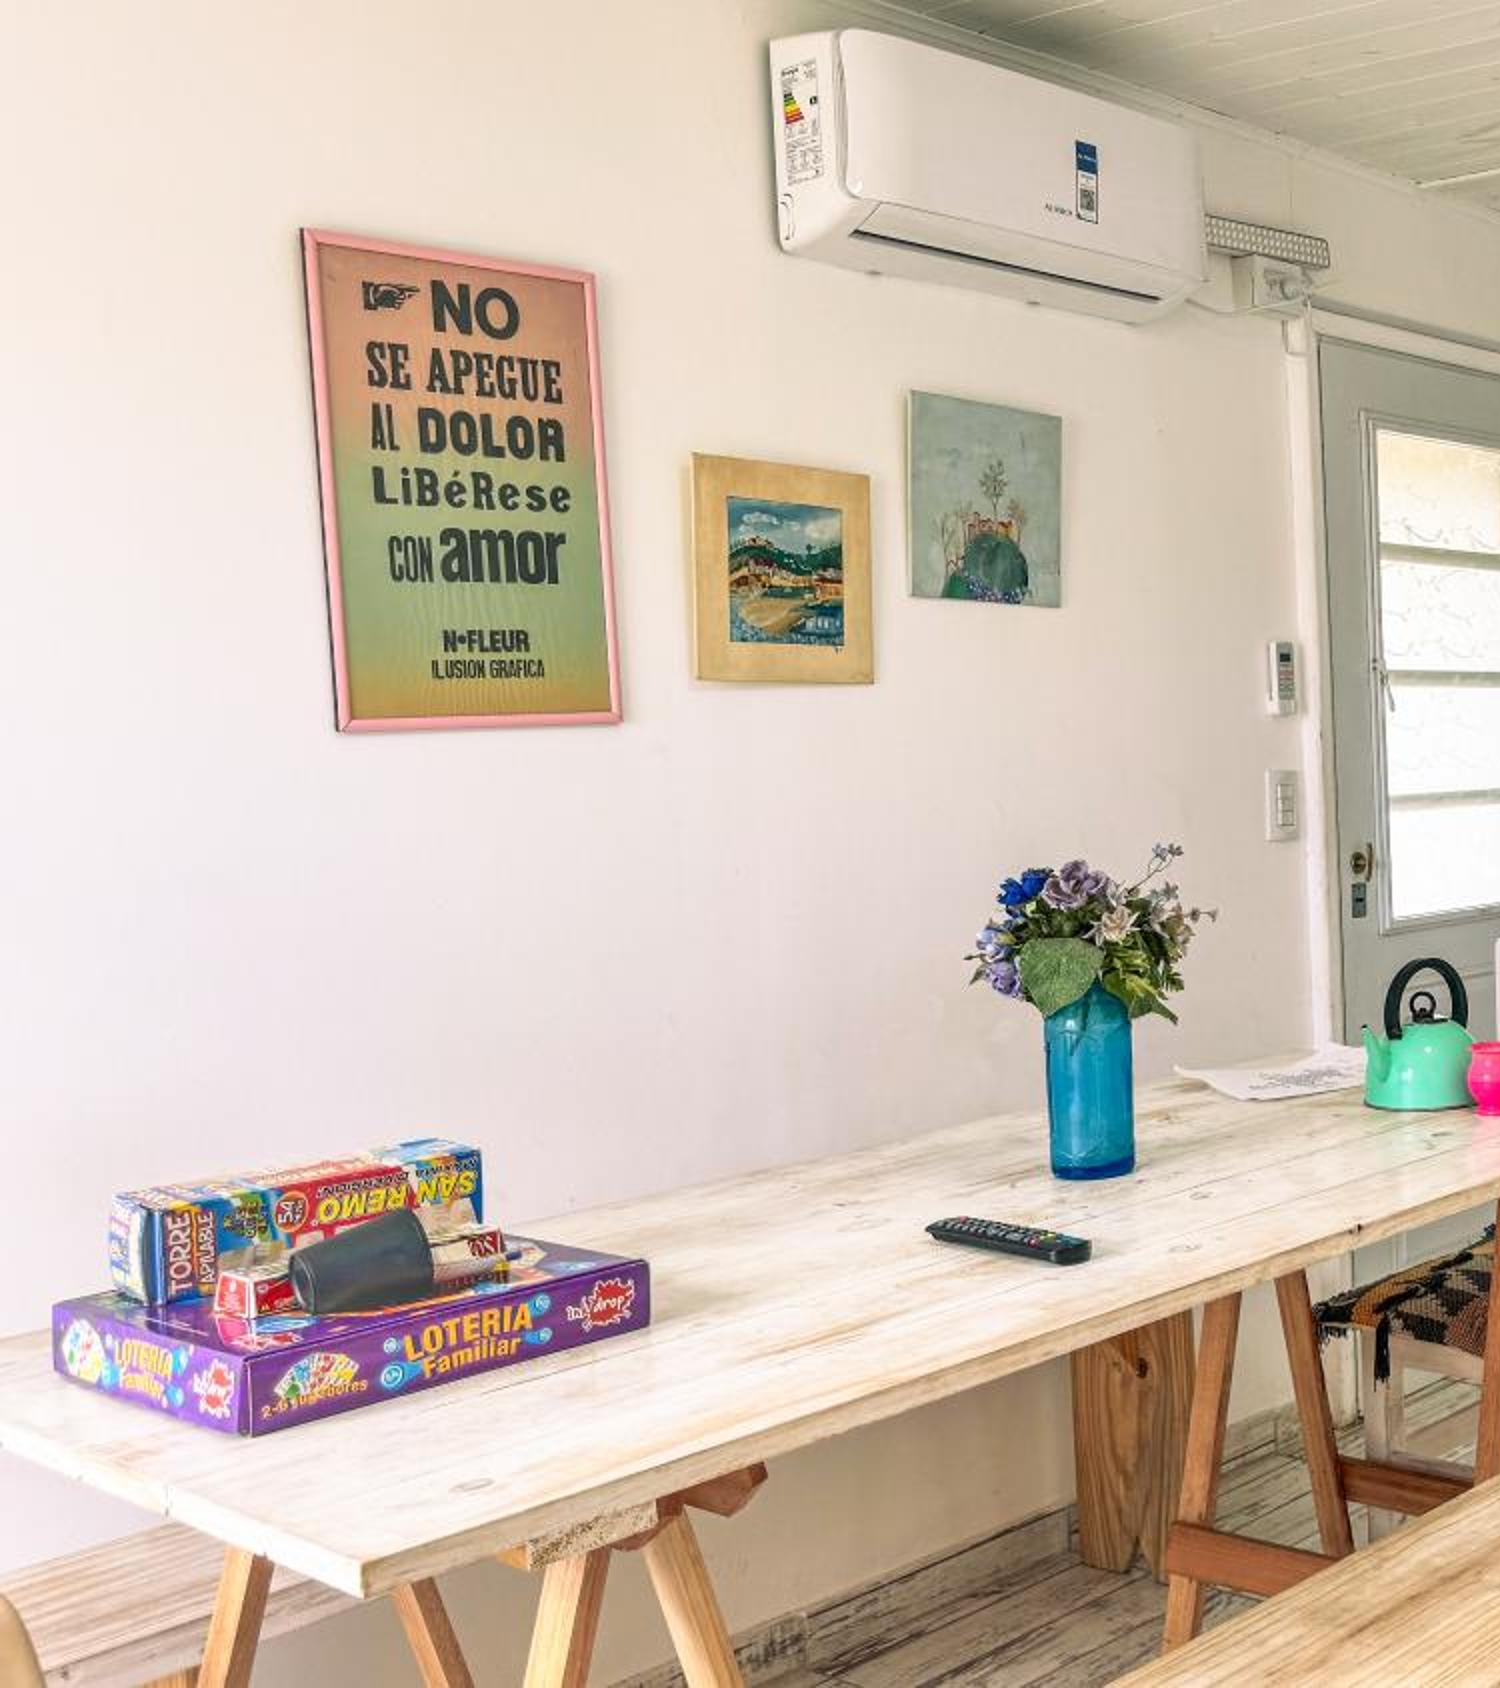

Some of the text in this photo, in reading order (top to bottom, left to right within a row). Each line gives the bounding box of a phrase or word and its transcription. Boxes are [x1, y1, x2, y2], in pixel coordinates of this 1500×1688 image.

[430, 280, 520, 340] NO
[366, 341, 563, 404] SE APEGUE
[371, 402, 566, 462] AL DOLOR
[388, 527, 567, 585] CON amor
[431, 659, 545, 679] ILUSION GRAFICA
[318, 1184, 408, 1224] REMO
[416, 1170, 477, 1204] SAN
[168, 1211, 193, 1298] TORRE
[404, 1302, 534, 1362] LOTERIA
[422, 1336, 522, 1378] Familiar
